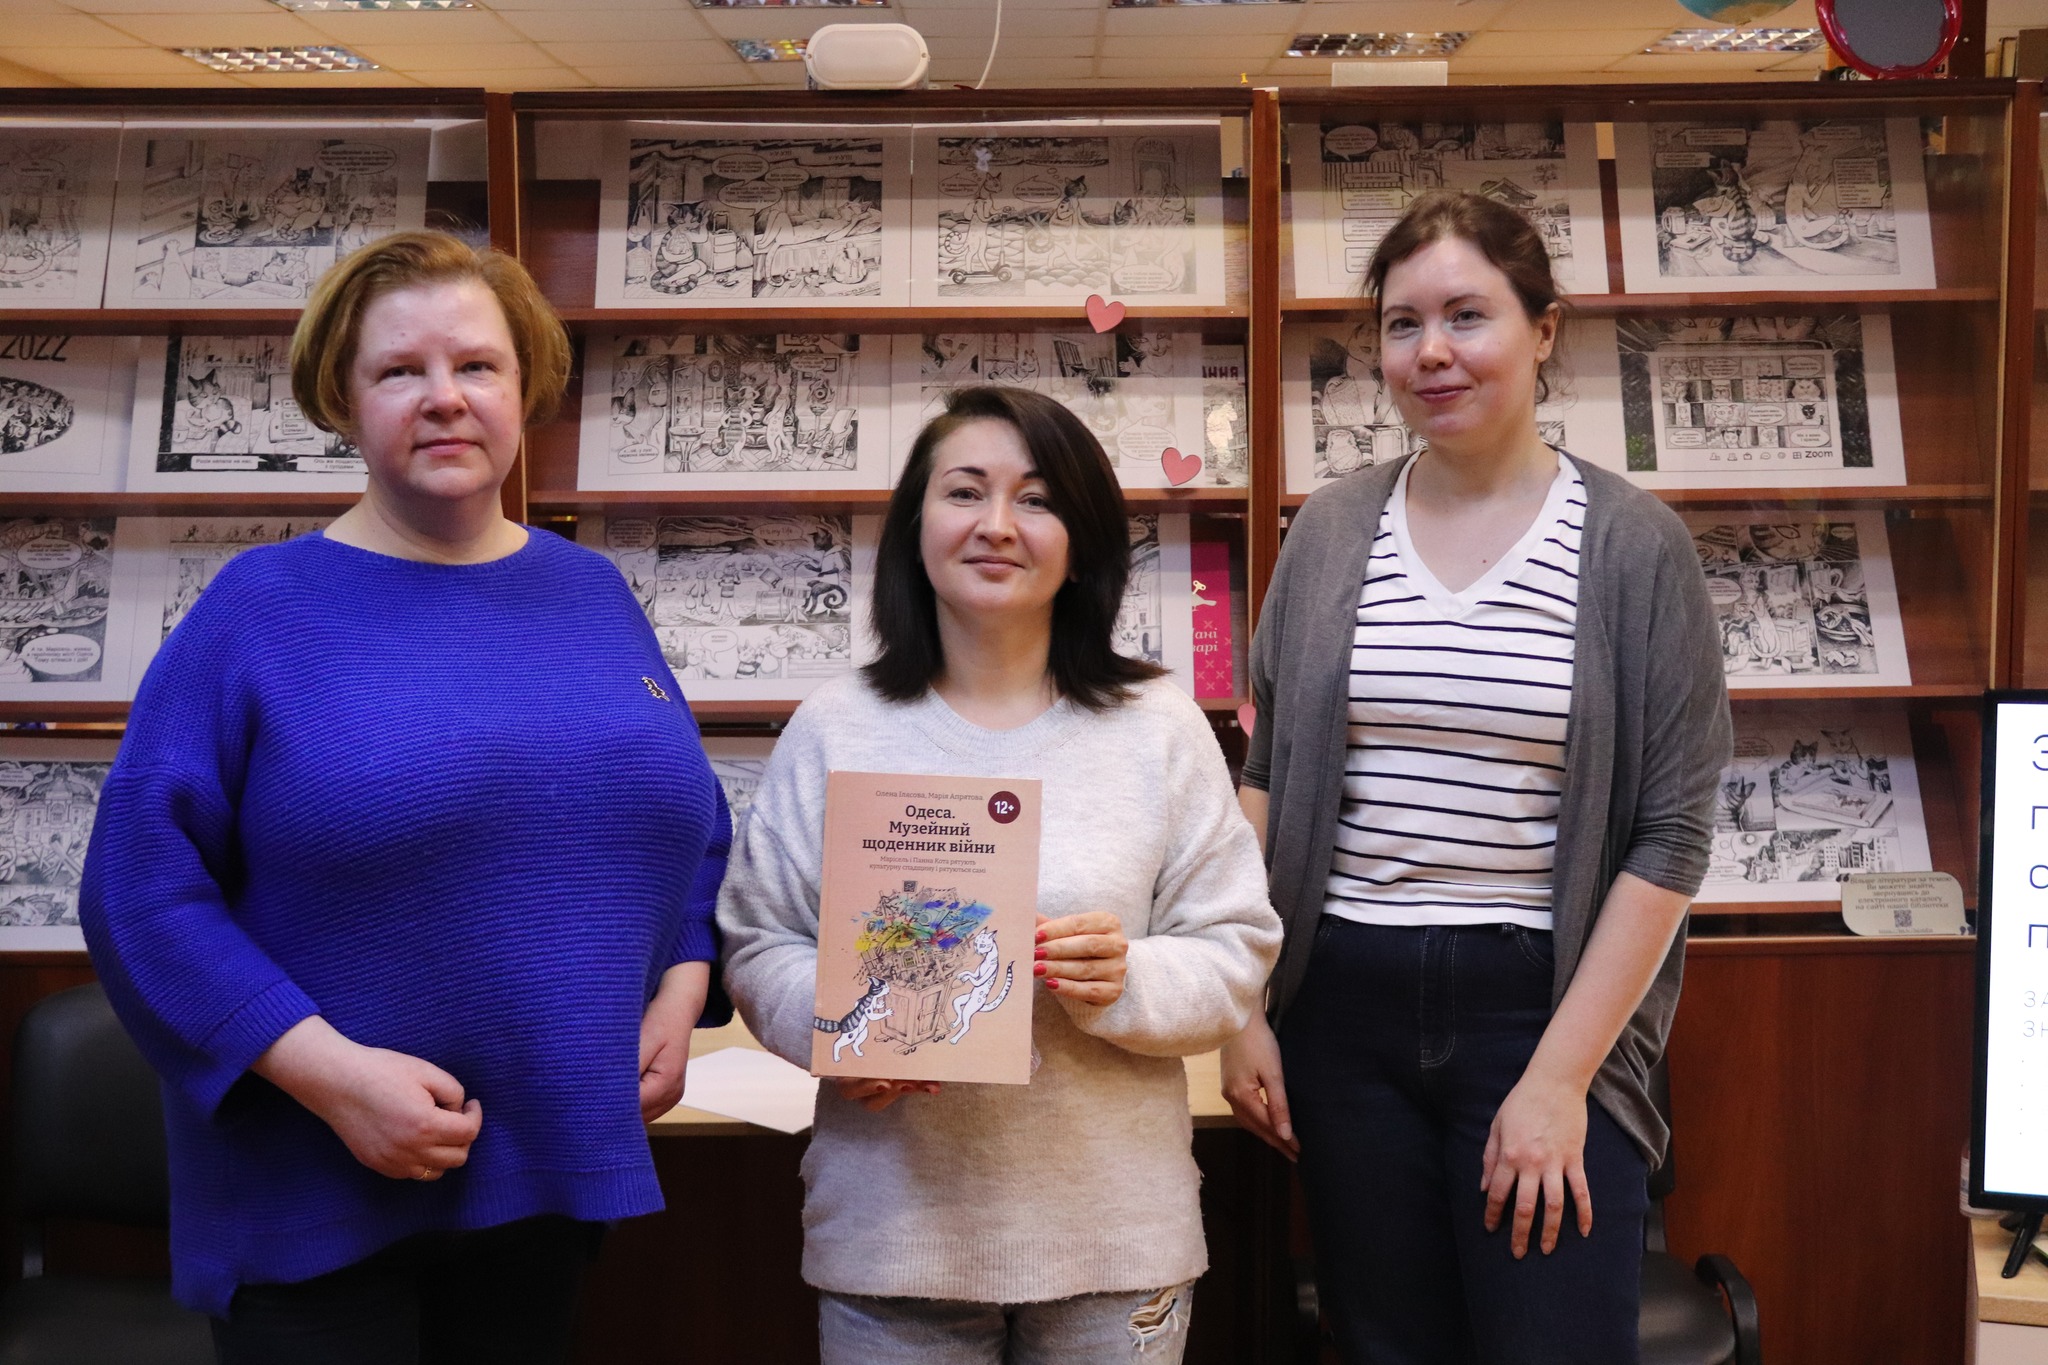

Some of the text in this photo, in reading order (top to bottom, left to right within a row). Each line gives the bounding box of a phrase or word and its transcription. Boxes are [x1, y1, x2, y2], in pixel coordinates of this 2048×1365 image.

[1193, 627, 1218, 639] ані
[876, 790, 898, 798] Олена
[928, 792, 949, 801] Марія
[905, 804, 956, 820] Одеса.
[994, 801, 1015, 814] 12+
[889, 820, 971, 837] Музейний
[862, 839, 995, 854] щоденник війни
[869, 864, 901, 872] культурну
[902, 865, 935, 873] спадщину
